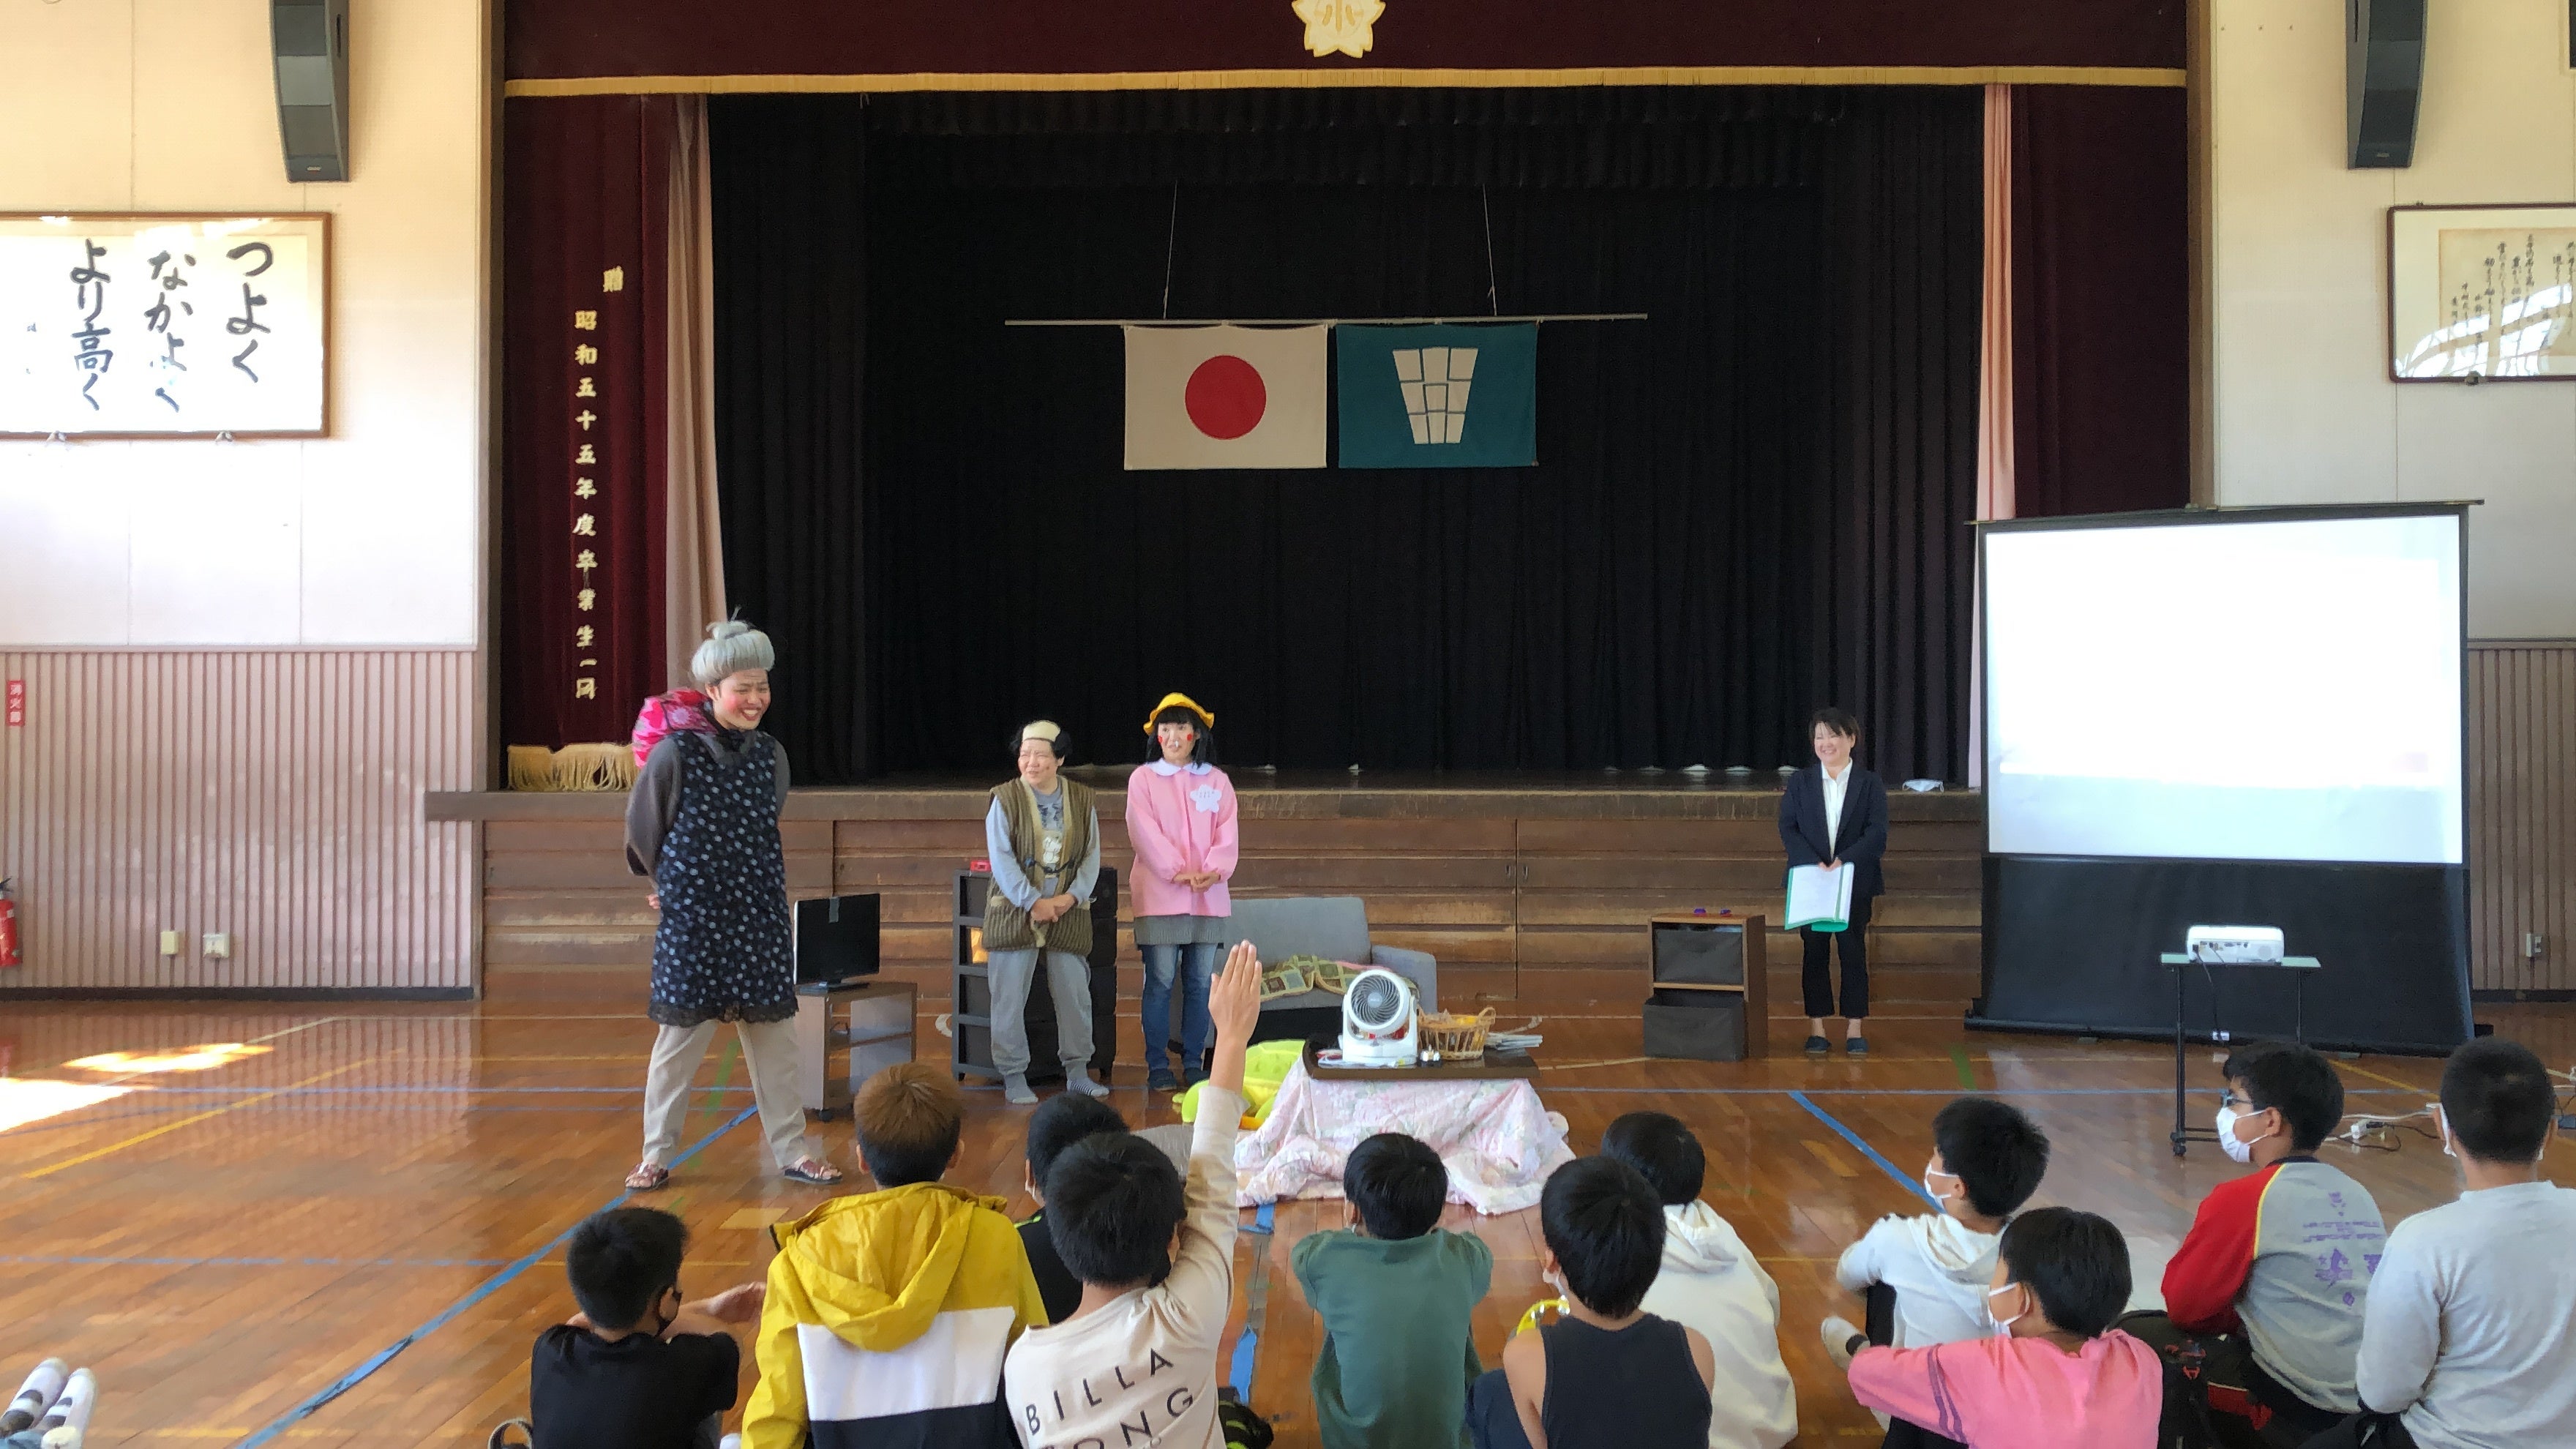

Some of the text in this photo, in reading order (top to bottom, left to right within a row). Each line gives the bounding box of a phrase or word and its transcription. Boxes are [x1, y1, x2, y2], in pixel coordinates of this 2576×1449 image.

[70, 238, 113, 411] より高く
[227, 242, 274, 383] つよく
[1025, 1348, 1173, 1435] BILLA
